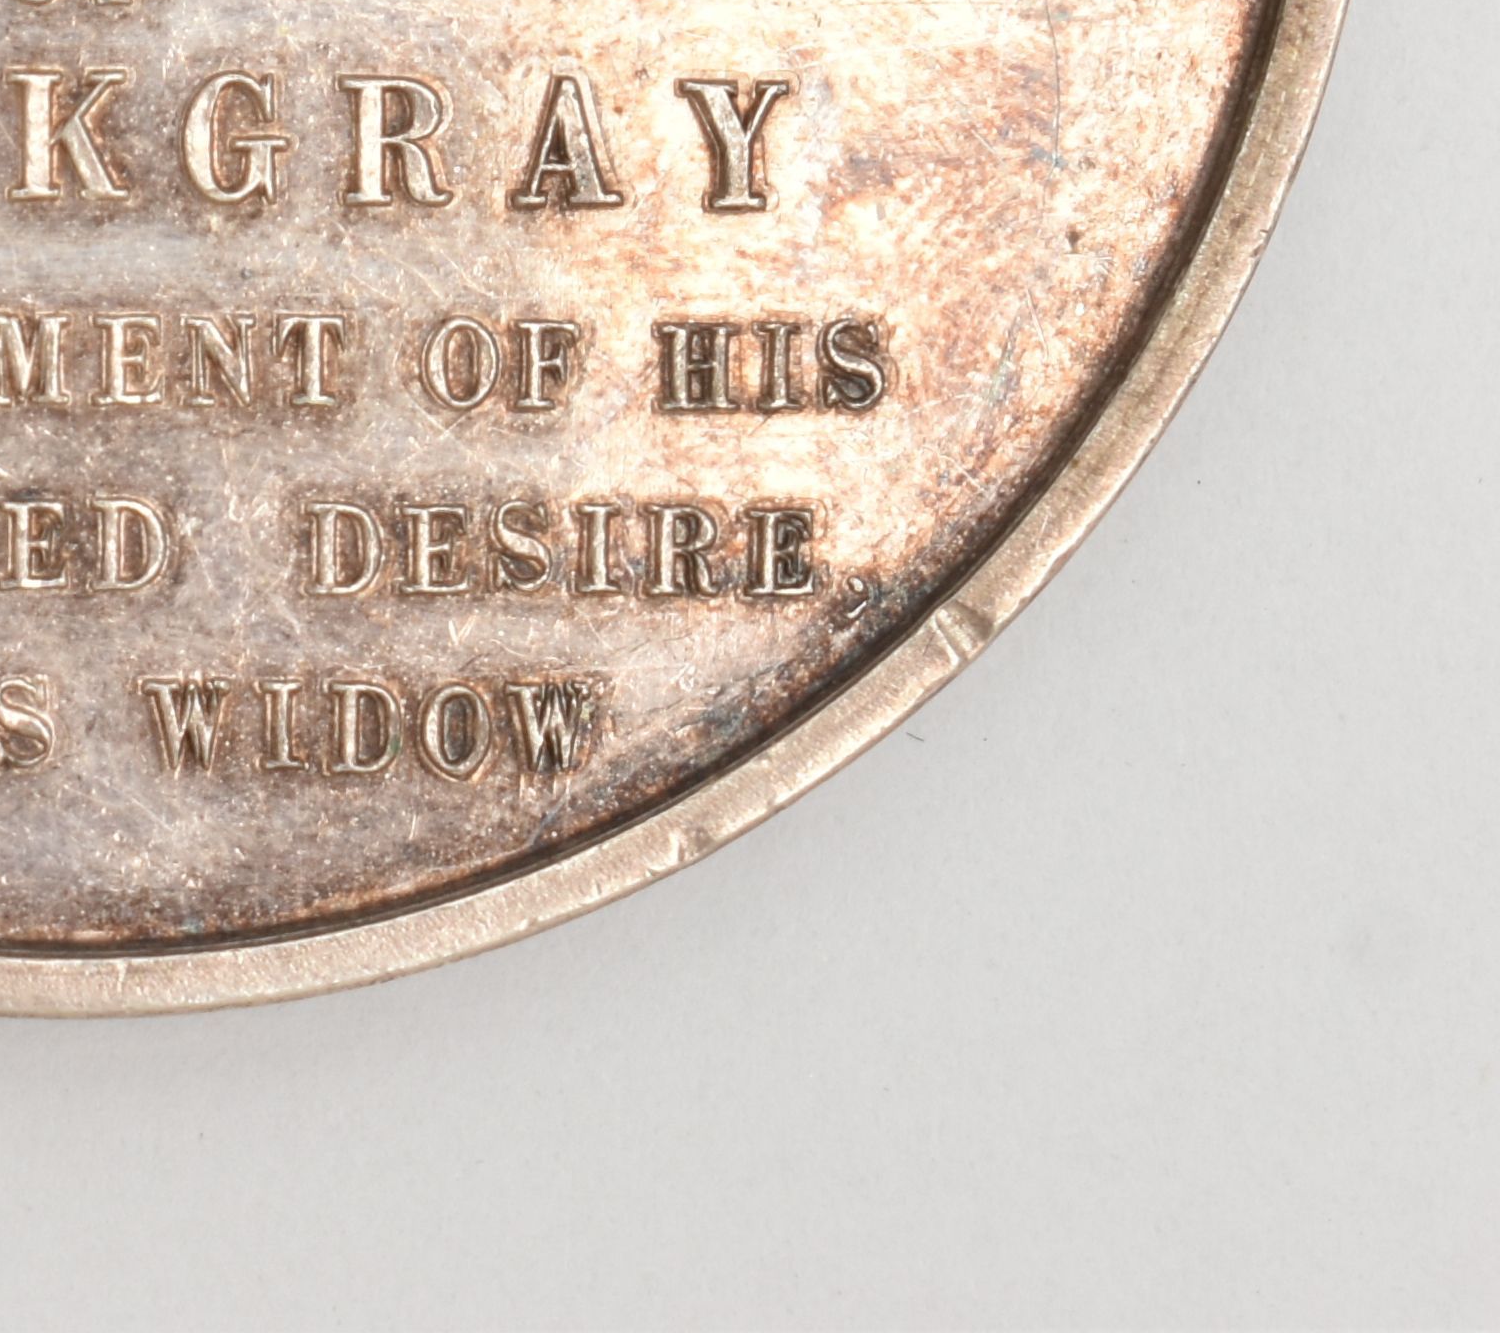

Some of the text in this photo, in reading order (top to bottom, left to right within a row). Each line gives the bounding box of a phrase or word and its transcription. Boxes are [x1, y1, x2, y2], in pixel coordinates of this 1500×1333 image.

[420, 315, 580, 411] OF
[659, 316, 891, 414] HIS
[141, 674, 600, 781] WIDOW
